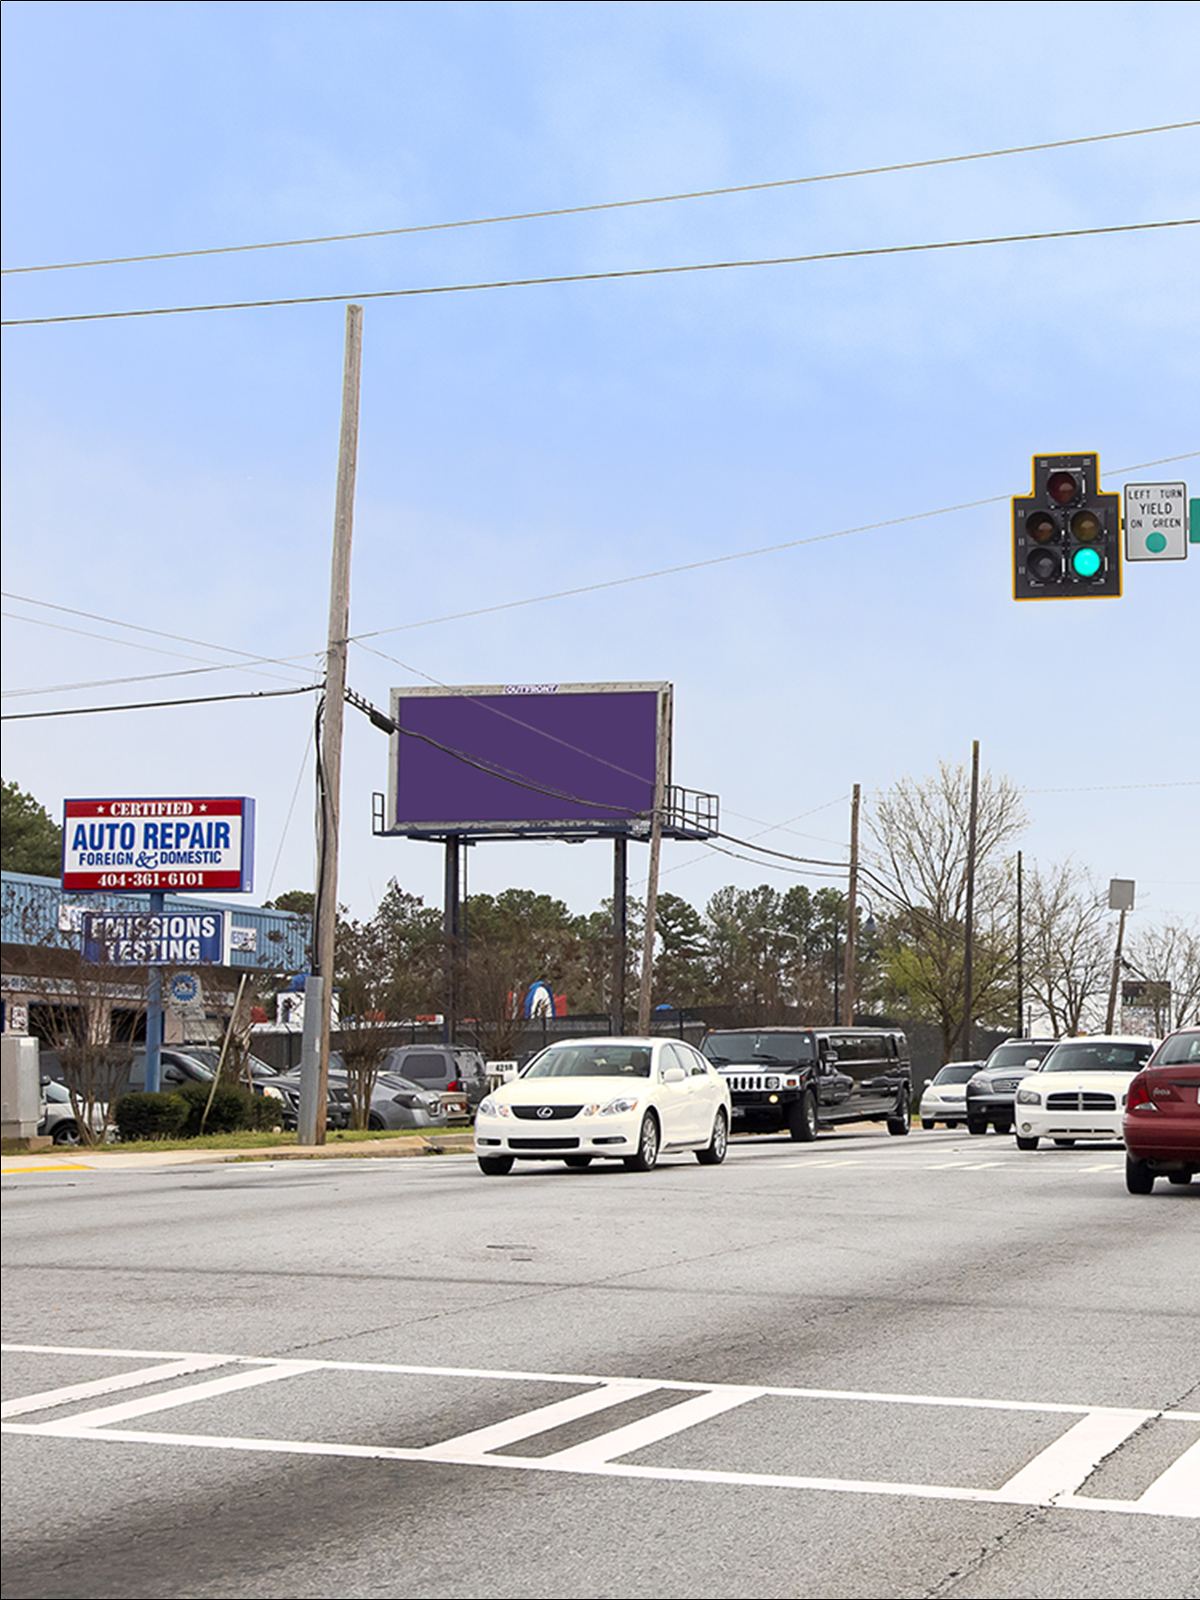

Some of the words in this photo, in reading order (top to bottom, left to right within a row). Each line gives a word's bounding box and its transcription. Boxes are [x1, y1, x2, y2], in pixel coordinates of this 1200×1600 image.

[1128, 489, 1150, 500] LEFT
[1160, 488, 1183, 499] TURN
[1139, 502, 1172, 515] YIELD
[1130, 518, 1143, 529] ON
[1152, 517, 1182, 528] GREEN
[109, 802, 193, 816] CERTIFIED
[72, 822, 136, 851] AUTO
[143, 821, 231, 850] REPAIR
[79, 852, 133, 866] FOREIGN
[135, 851, 158, 869] &
[160, 850, 222, 865] DOMESTIC
[91, 916, 216, 938] EMISSIONS
[105, 939, 200, 961] TESTING
